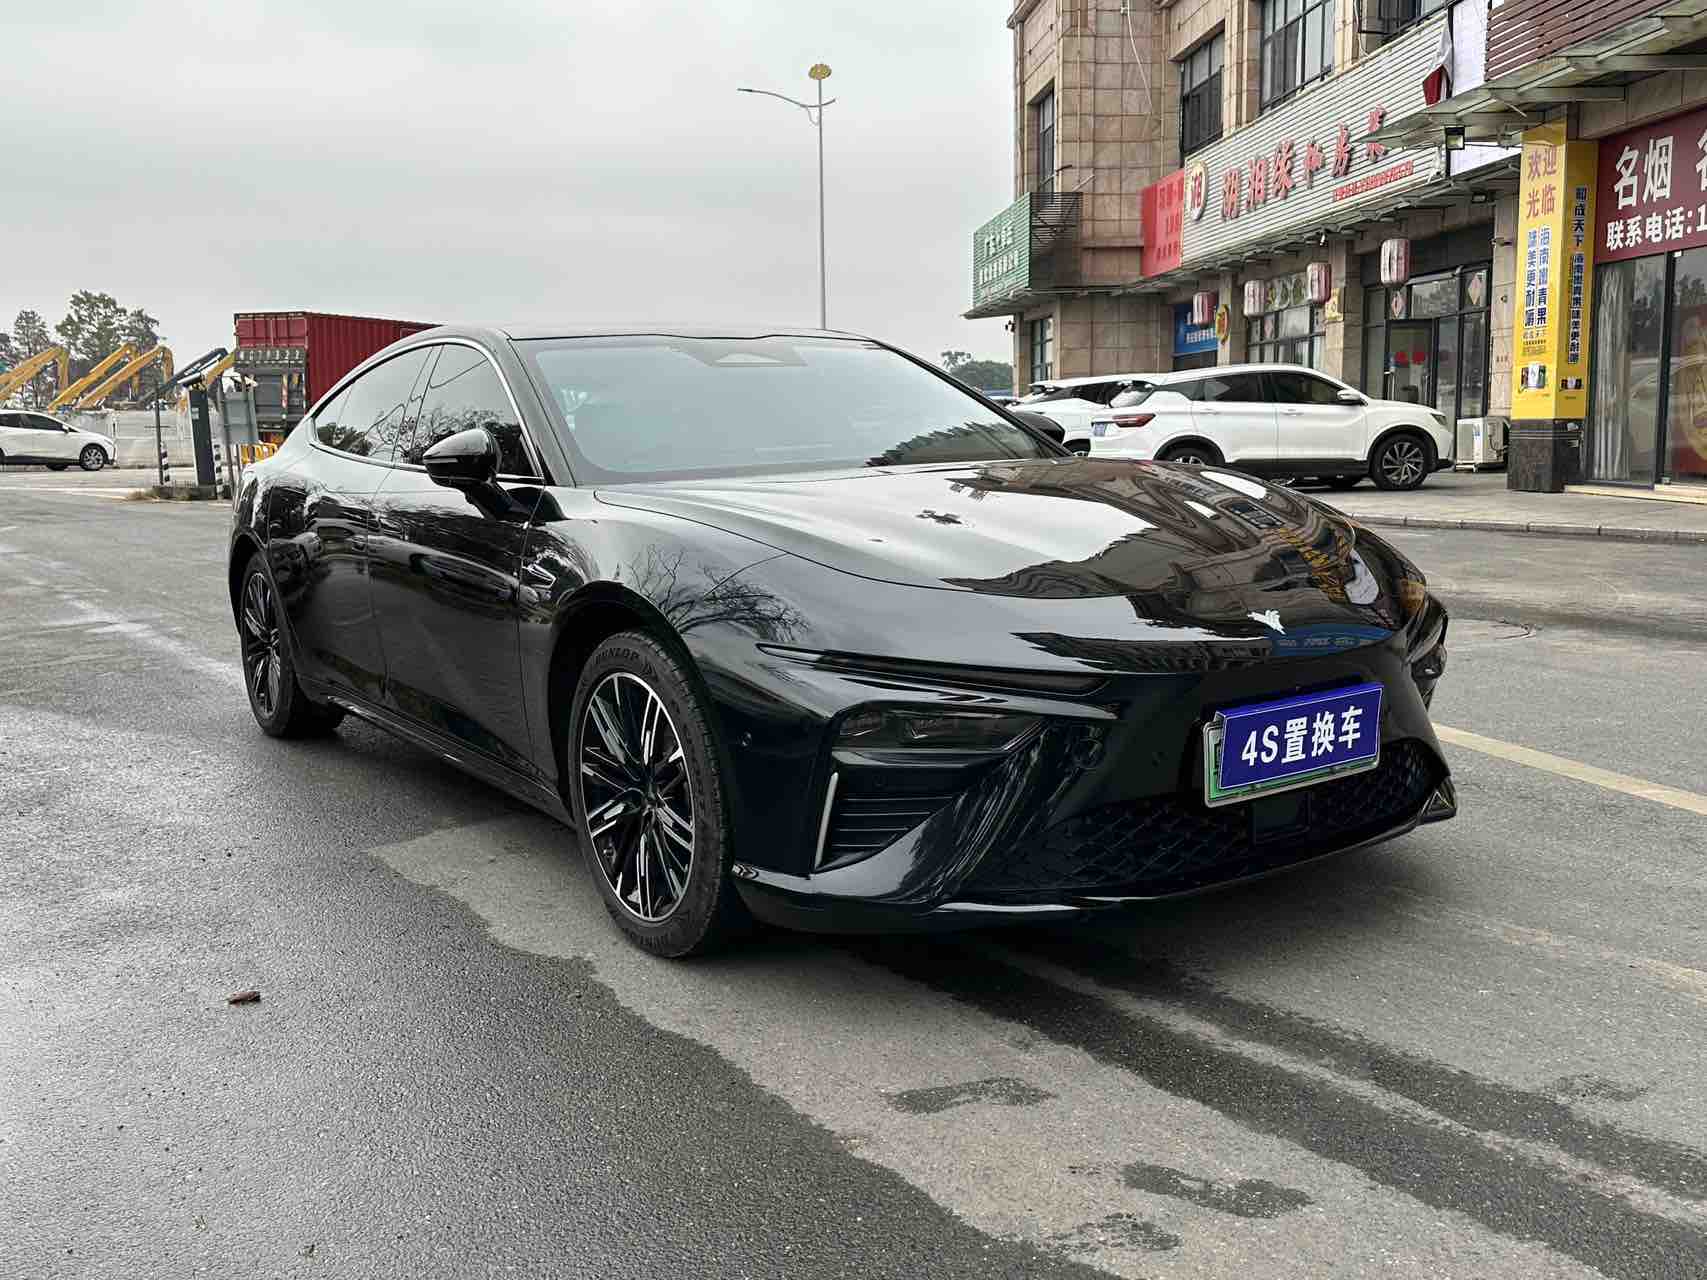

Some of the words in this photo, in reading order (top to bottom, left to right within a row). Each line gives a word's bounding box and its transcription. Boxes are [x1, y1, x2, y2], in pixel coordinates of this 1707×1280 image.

[1527, 145, 1558, 181] 欢迎
[1613, 135, 1674, 210] 名烟
[1526, 184, 1556, 221] 光临
[595, 647, 641, 665] DUNLOP
[1241, 705, 1363, 766] 4S置换车
